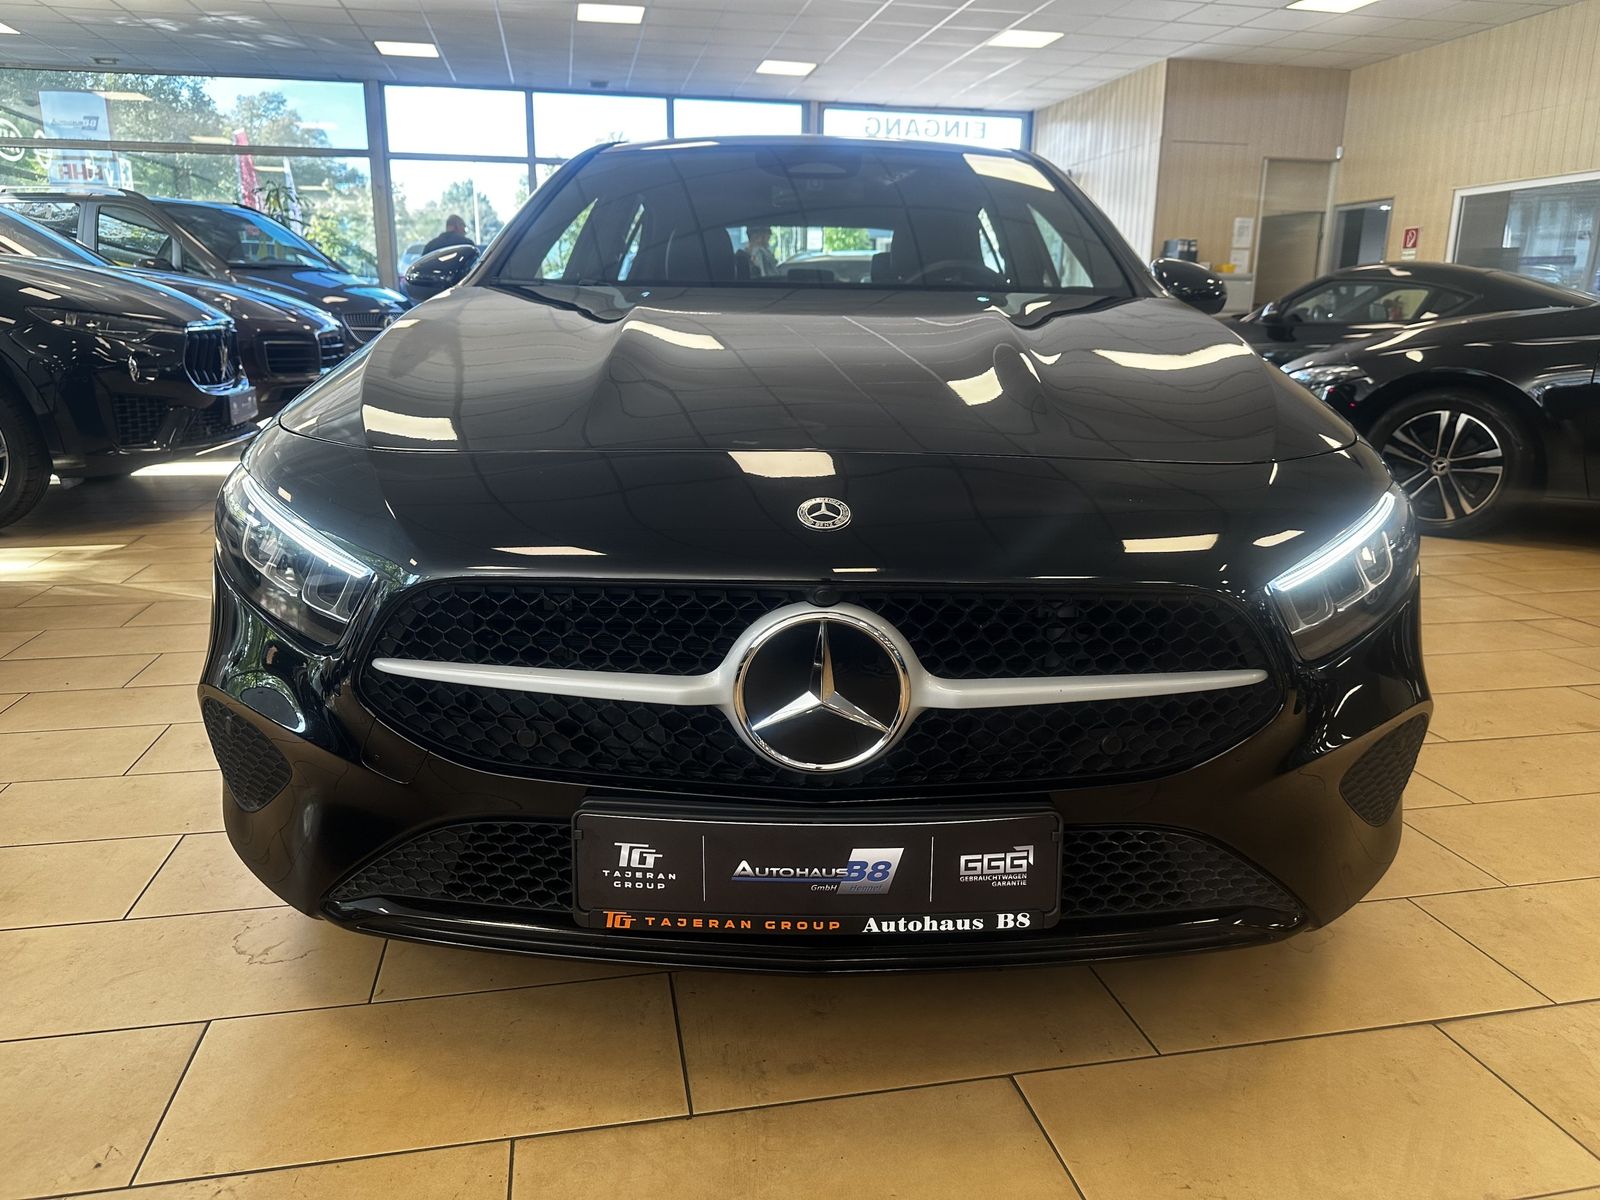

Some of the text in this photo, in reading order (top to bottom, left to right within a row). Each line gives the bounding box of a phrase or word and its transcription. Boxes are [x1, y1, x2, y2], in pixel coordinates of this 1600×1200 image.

[959, 851, 1028, 875] GGG
[602, 870, 676, 880] TAJERAN
[847, 860, 893, 882] B8
[959, 873, 1028, 882] GEBRAUCHTWAGEN
[613, 881, 665, 889] GROUP
[810, 884, 838, 892] GmbH
[644, 917, 751, 929] TAJERAN
[764, 921, 840, 930] GROUP
[862, 912, 1031, 933] Autohaus B8
